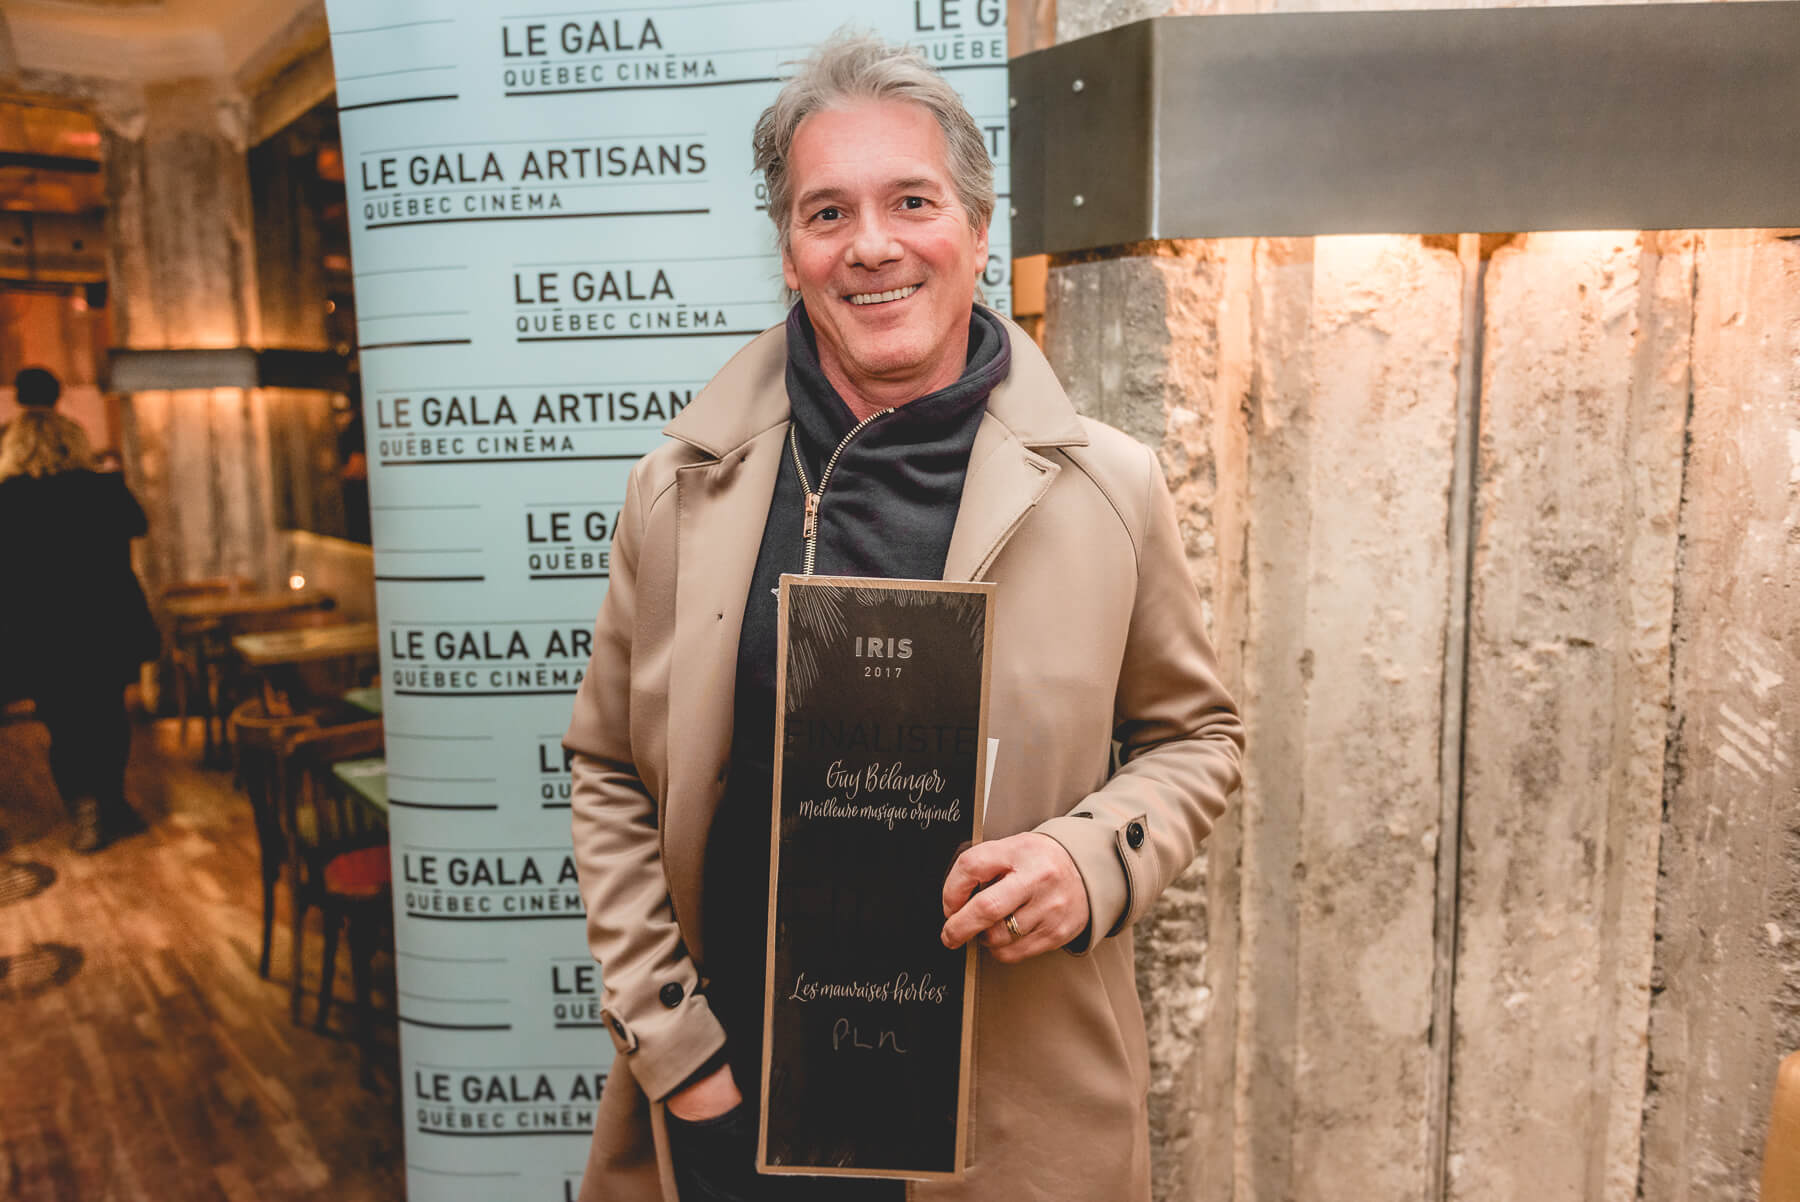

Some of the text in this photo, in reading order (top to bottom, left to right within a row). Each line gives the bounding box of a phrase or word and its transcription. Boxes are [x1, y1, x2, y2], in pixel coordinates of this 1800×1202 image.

[914, 0, 961, 31] LE
[502, 18, 663, 57] LE GALA
[361, 143, 707, 191] LE GALA ARTISANS
[514, 269, 674, 304] LE GALA
[377, 398, 412, 429] LE
[422, 395, 517, 427] GALA
[527, 512, 572, 543] LE
[391, 630, 425, 660] LE
[436, 630, 530, 660] GALA
[855, 636, 913, 659] IRIS
[864, 666, 902, 679] 2017
[785, 719, 977, 753] FINALISTE
[826, 760, 946, 803] Guy Bélanger
[800, 797, 961, 831] Meilleure musique originale
[403, 853, 437, 884] LE
[449, 855, 543, 886] GALA
[552, 966, 595, 994] LE
[789, 971, 947, 1004] Les mauvaises herbes
[415, 1071, 450, 1102] LE
[462, 1075, 556, 1103] GALA
